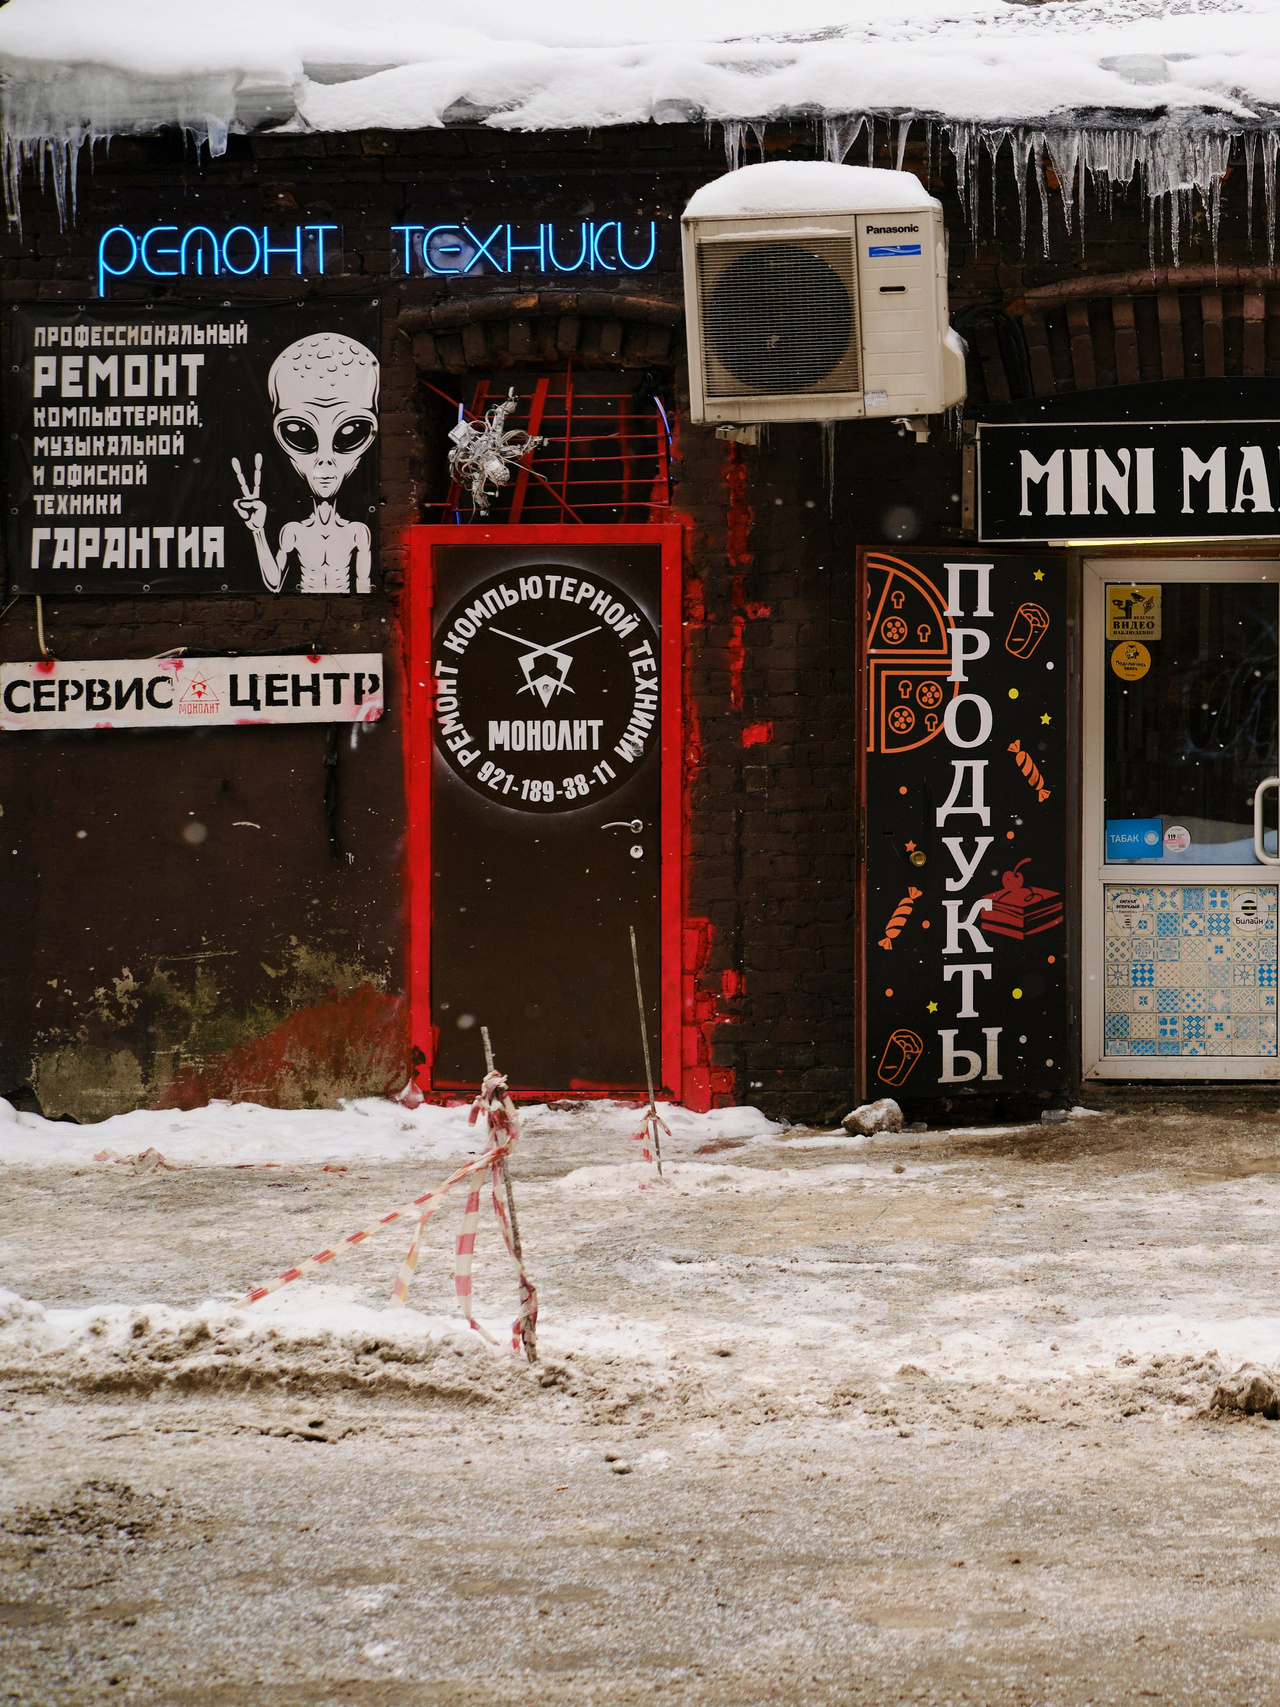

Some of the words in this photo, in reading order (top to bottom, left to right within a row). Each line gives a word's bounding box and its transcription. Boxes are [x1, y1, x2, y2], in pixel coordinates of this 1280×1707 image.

[866, 223, 920, 235] Panasonic
[34, 319, 248, 348] ПРОФЕССИОНАЛЬНЫЙ
[33, 353, 205, 398] РЕМОНТ
[33, 401, 203, 428] КОМПЬЮТЕРНОЙ,
[33, 430, 184, 457] МУЗЫКАЛЬНОЙ
[33, 465, 45, 486] И
[53, 460, 148, 487] ОФИСНОЙ
[1019, 447, 1157, 516] MINI
[33, 494, 122, 515] ТЕХНИКИ
[31, 526, 225, 569] ГАРАНТИЯ
[443, 574, 642, 655] КОМПЬЮТЕРНОЙ
[1113, 621, 1155, 631] ВИДЕО
[3, 675, 173, 714] СЕРВИС
[229, 672, 381, 711] ЦЕНТР
[178, 702, 220, 715] МОНОЛИТ
[613, 639, 659, 764] ТЕХНИКИ
[434, 660, 482, 768] РЕМОНТ
[488, 719, 604, 752] МОНОЛИТ
[476, 760, 617, 803] 921-189-38-11
[936, 562, 1003, 1084] ПРОДУКТЫ
[1110, 834, 1140, 843] ТАБАК
[1235, 917, 1264, 925] Билайн
